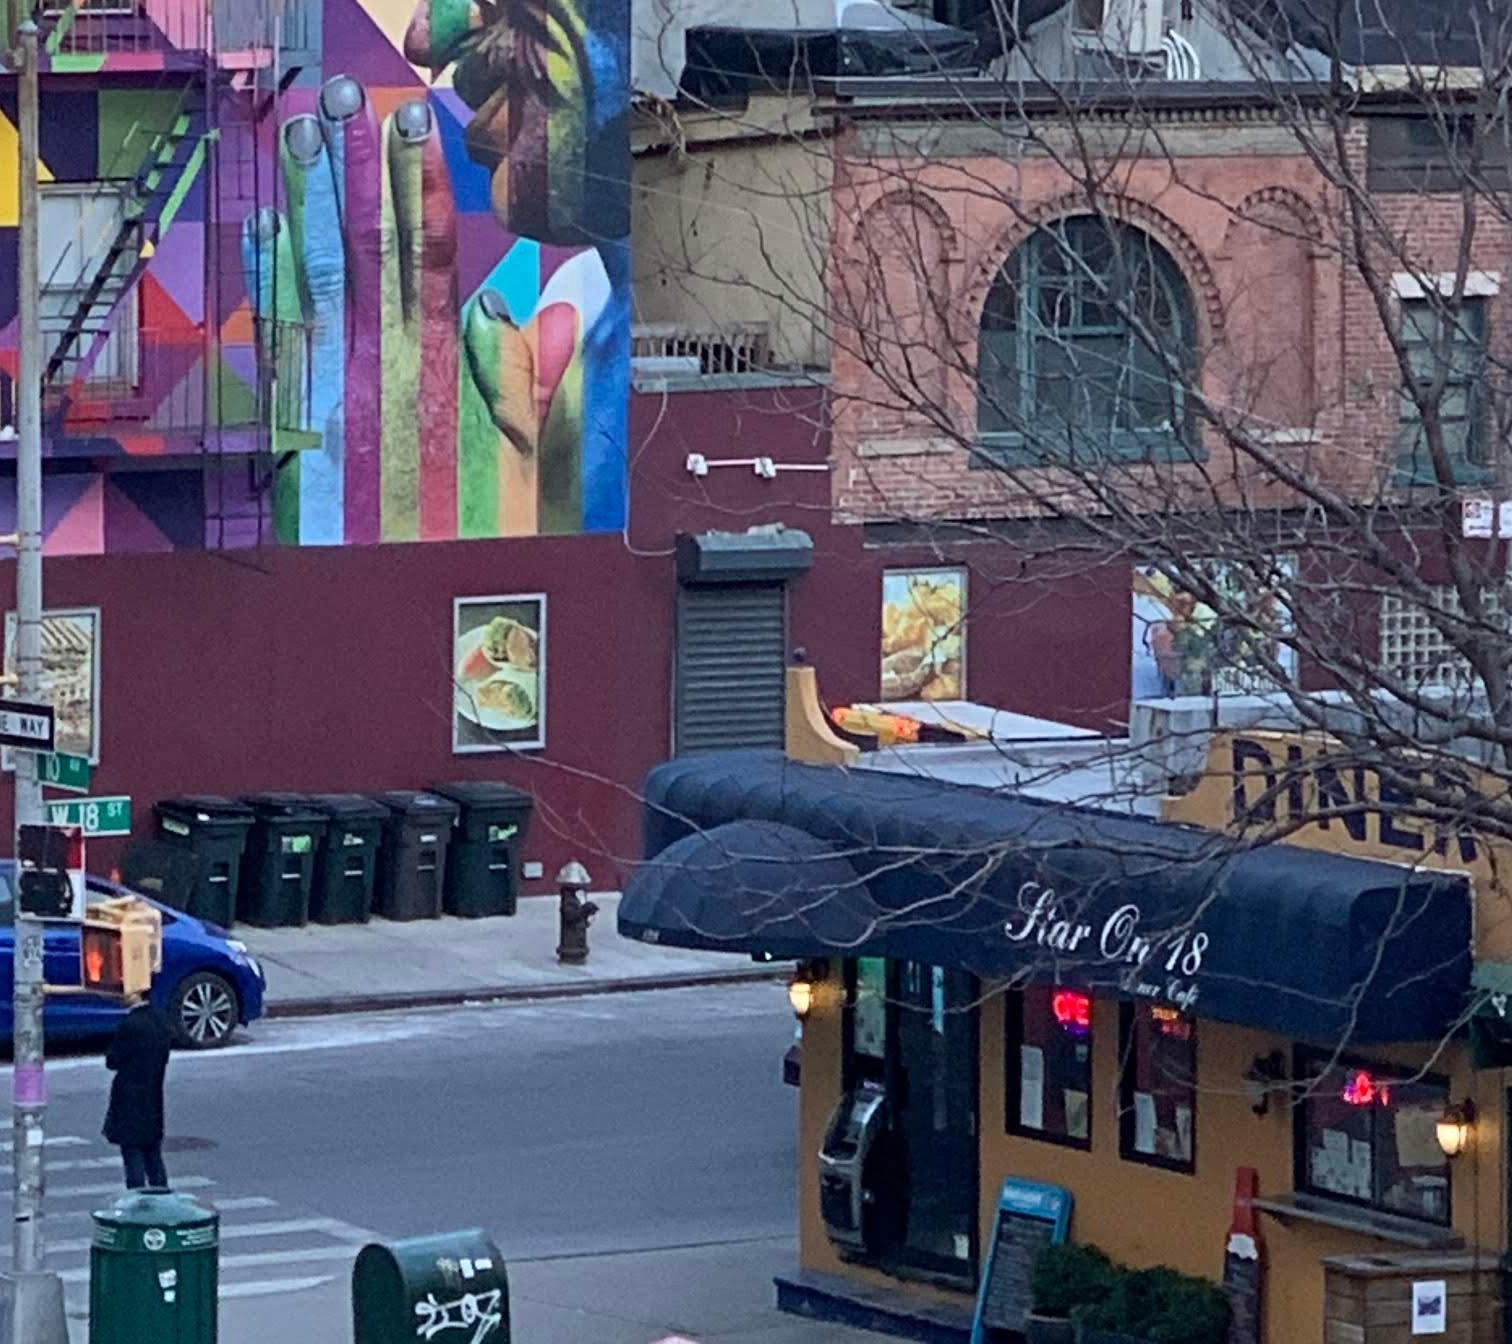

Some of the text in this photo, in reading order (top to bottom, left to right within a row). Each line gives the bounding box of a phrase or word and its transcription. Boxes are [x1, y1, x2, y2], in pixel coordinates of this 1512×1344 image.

[19, 716, 44, 735] WAY
[51, 802, 125, 831] W 18 ST
[1004, 880, 1209, 977] Star On 18
